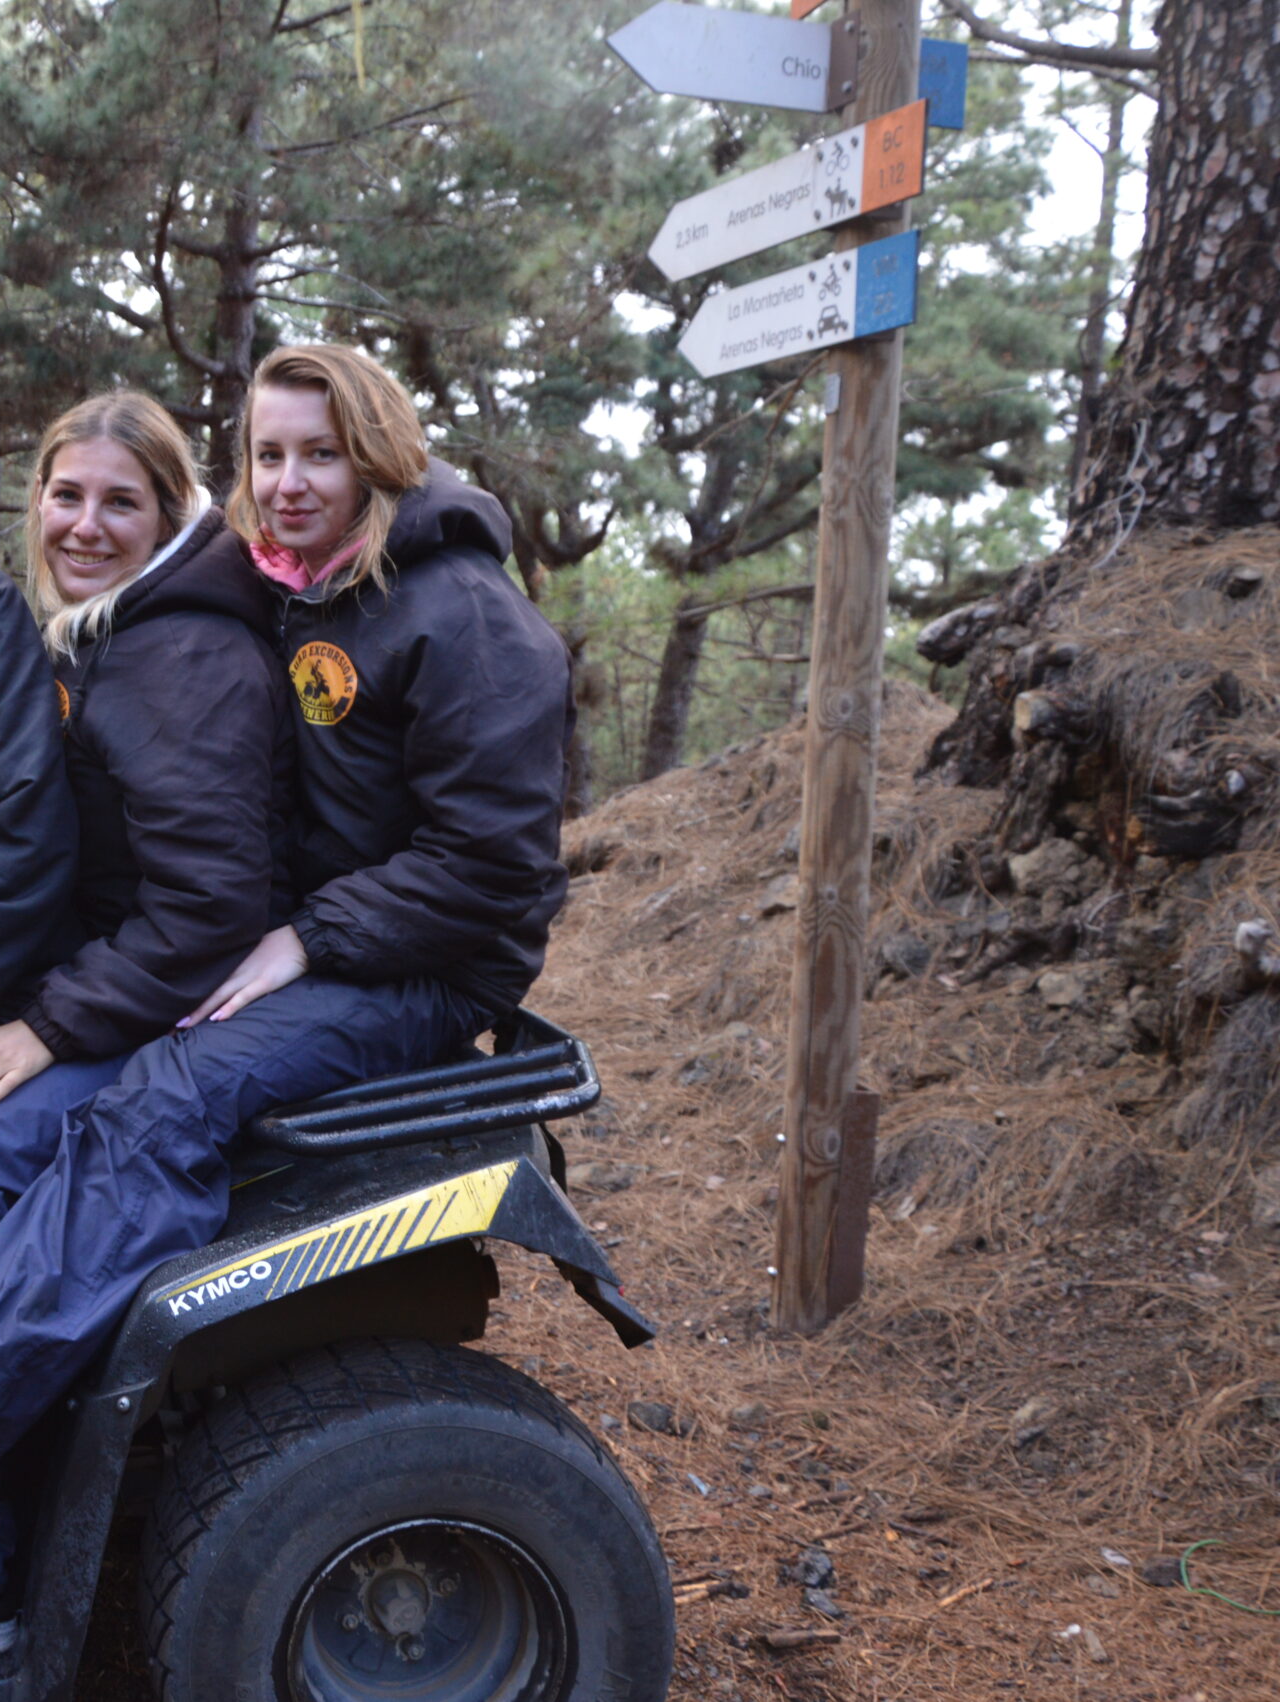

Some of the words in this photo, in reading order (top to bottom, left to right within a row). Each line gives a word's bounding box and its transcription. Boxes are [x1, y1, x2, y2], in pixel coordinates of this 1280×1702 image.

[882, 124, 903, 153] BC
[727, 200, 766, 228] Arenas
[768, 182, 811, 212] Negras
[728, 302, 741, 321] La
[719, 337, 759, 360] Arenas
[760, 323, 804, 350] Negras
[308, 645, 354, 694] EXCURSIONS
[168, 1260, 272, 1316] KYMCO
